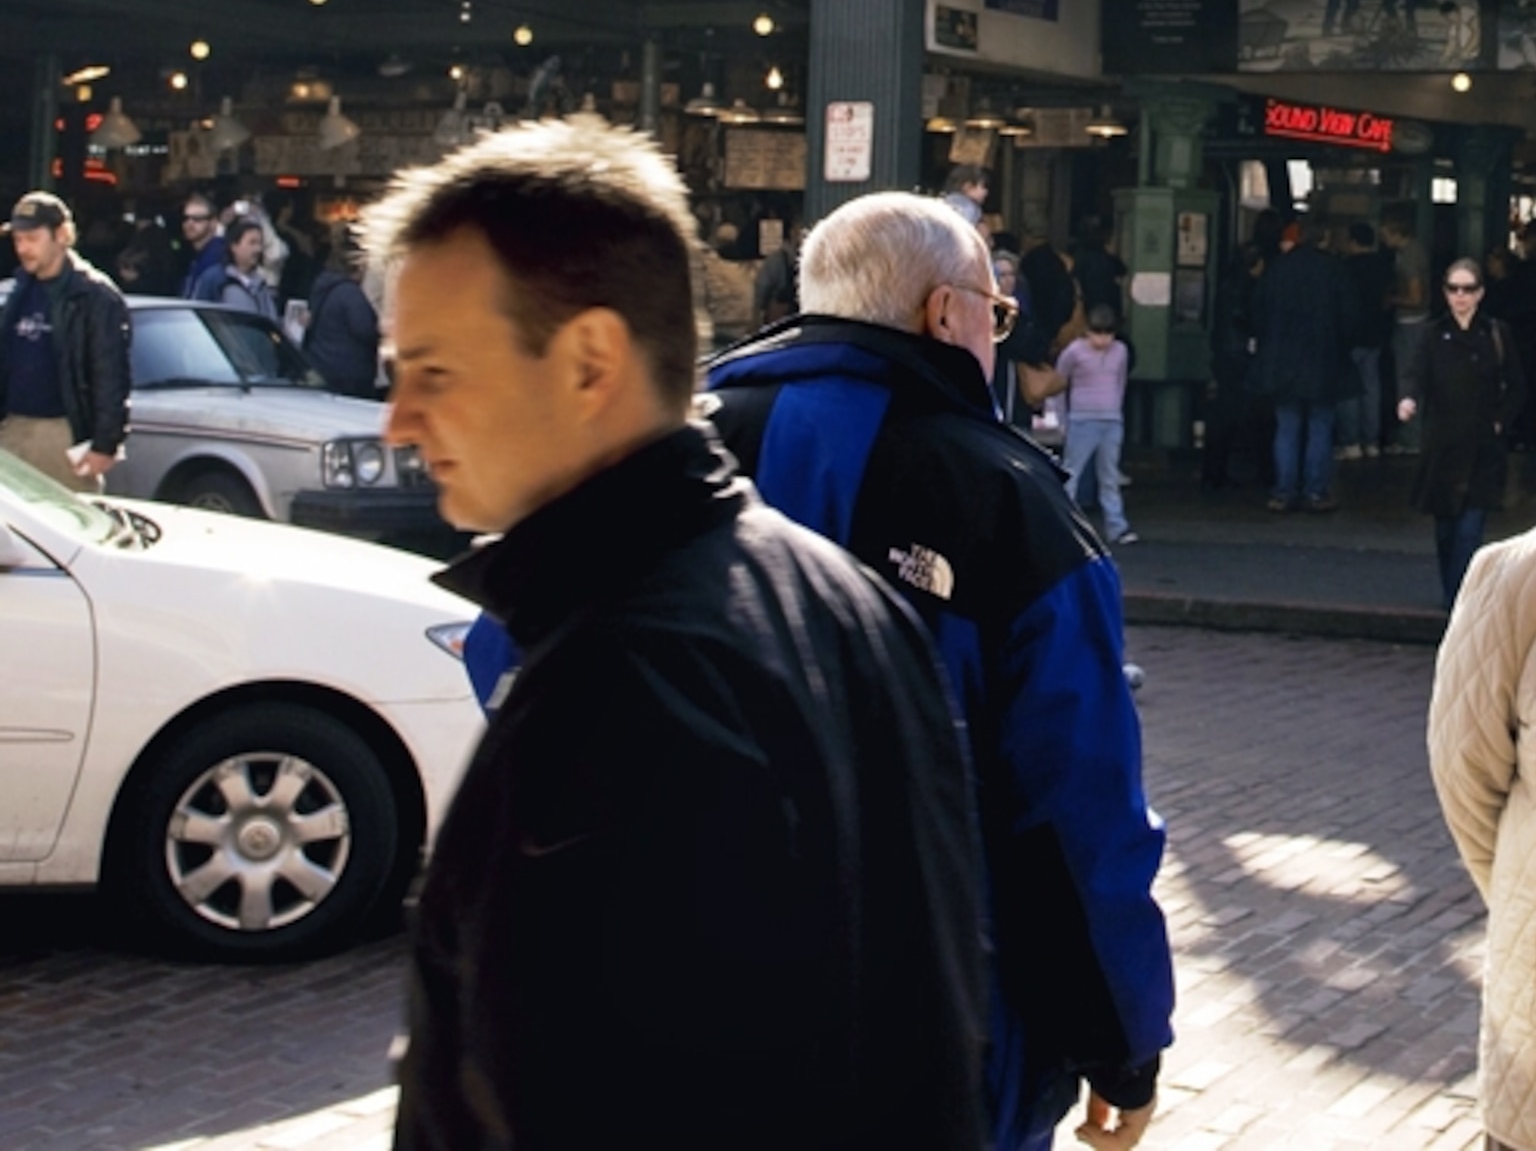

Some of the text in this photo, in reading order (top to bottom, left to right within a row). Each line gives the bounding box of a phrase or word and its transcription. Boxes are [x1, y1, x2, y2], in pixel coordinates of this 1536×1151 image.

[1265, 99, 1393, 141] SOUND VIEW CAFE
